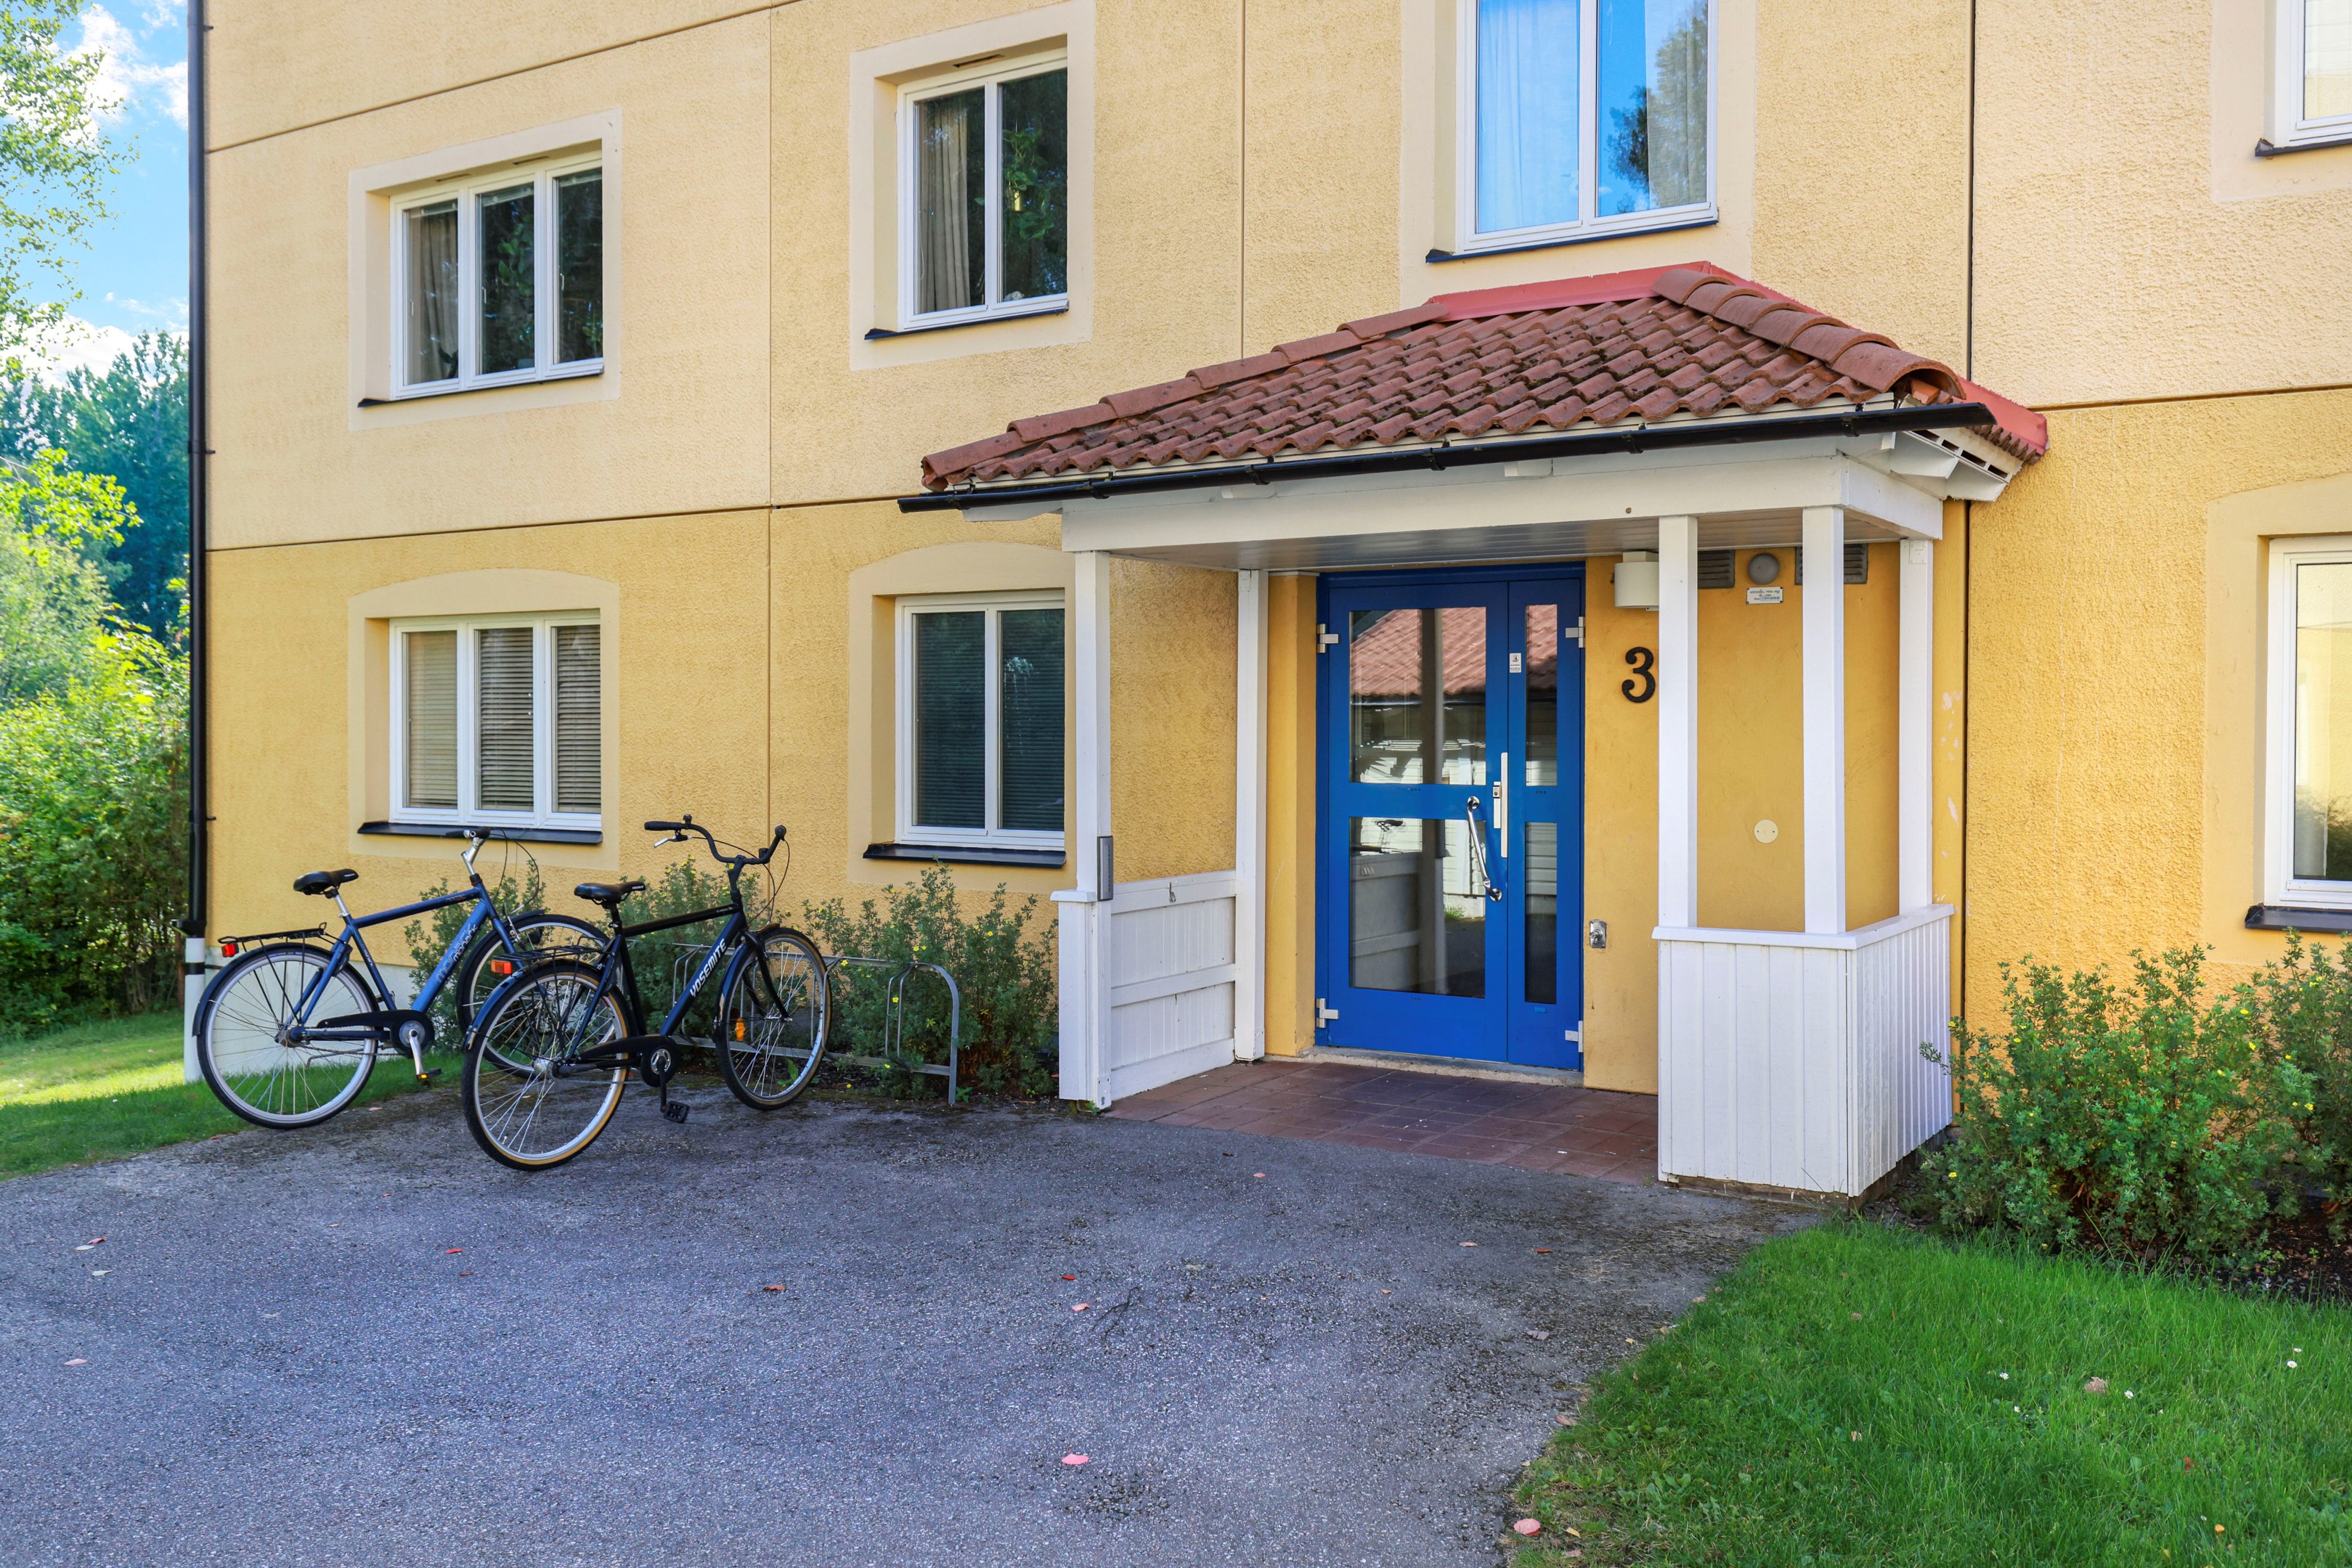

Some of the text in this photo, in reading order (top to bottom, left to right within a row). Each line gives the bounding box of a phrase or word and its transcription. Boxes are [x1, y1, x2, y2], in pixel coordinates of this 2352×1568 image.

[1621, 646, 1656, 703] 3
[452, 923, 478, 962] monark
[689, 938, 727, 997] YOSEMITE
